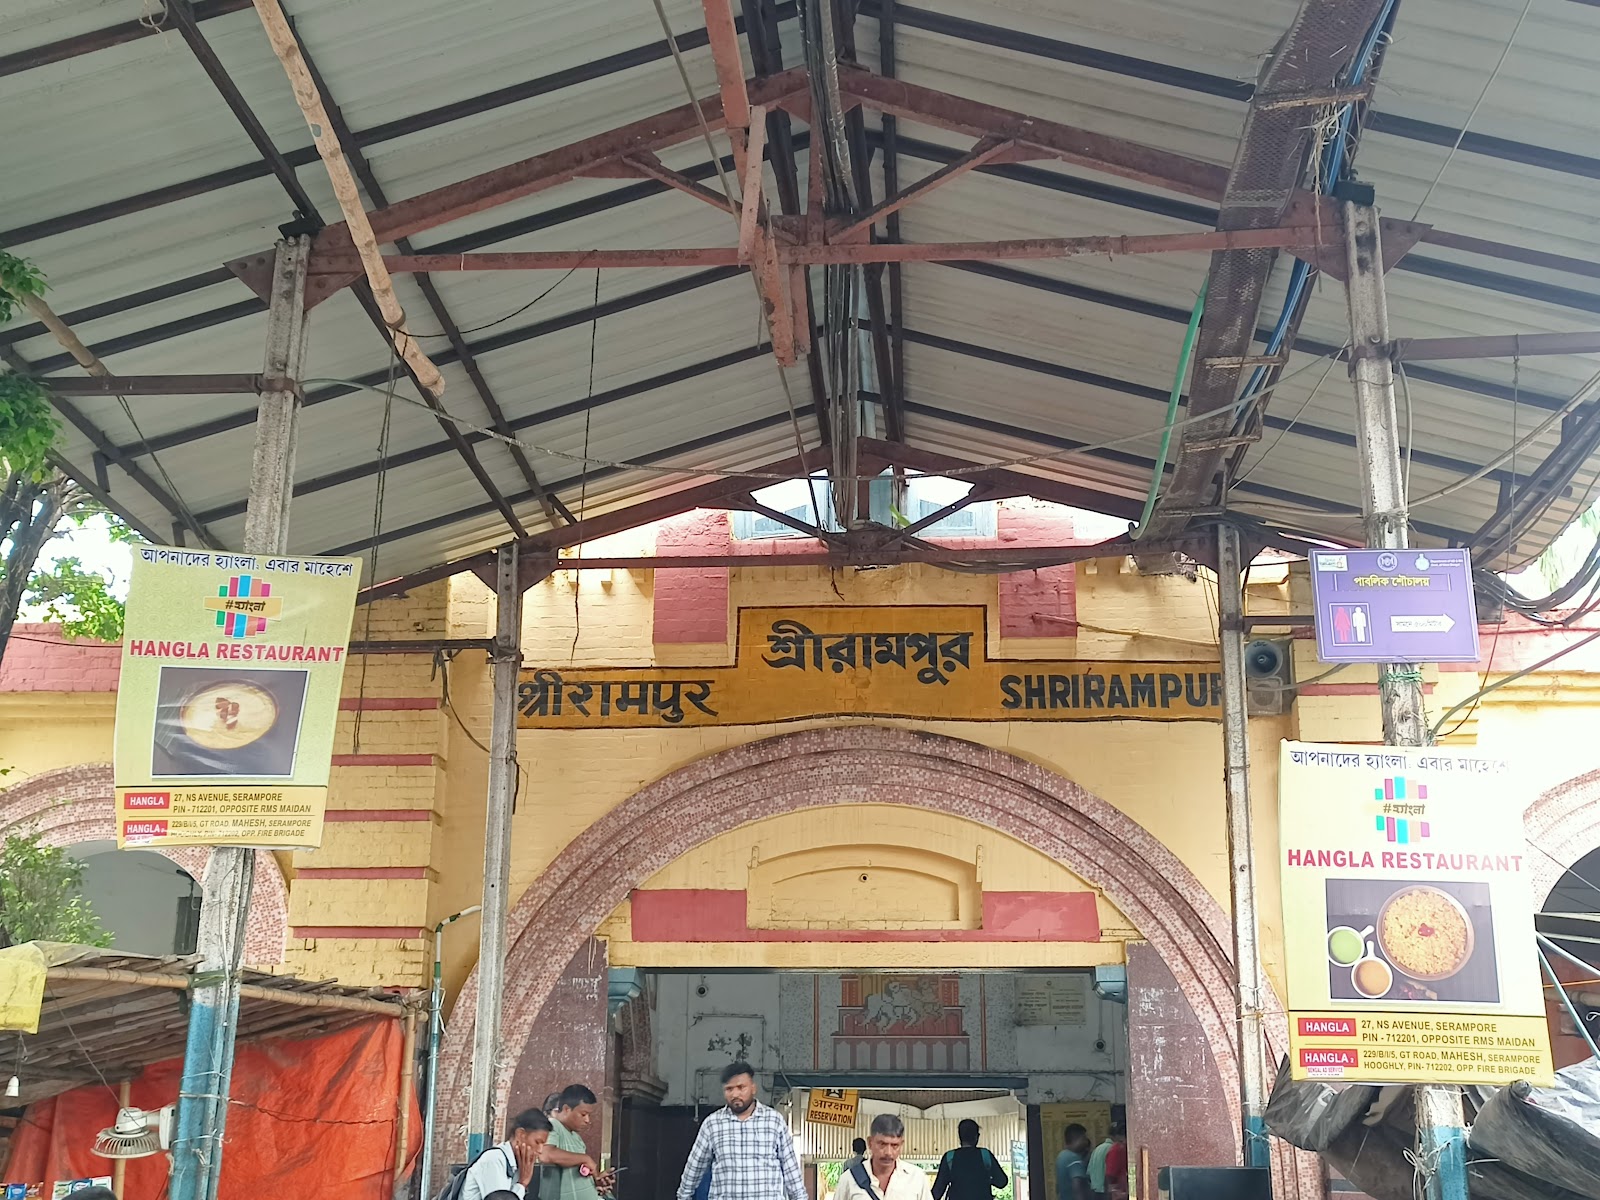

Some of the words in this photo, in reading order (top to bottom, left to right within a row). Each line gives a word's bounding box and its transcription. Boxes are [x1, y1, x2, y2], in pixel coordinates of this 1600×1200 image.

[140, 548, 210, 566] আপনাদের
[265, 560, 300, 572] এবার
[304, 562, 352, 576] মাহেশে
[1354, 574, 1390, 587] পাবলিক
[130, 640, 209, 658] HANGLA
[217, 643, 343, 662] RESTAURANT
[761, 619, 974, 686] শ্রীরামপুর
[518, 670, 718, 723] श्रीरामपुर
[1290, 751, 1360, 768] আপনাদের
[1417, 757, 1452, 771] এবার
[130, 794, 165, 805] HANGLA
[174, 794, 184, 802] 27,
[198, 793, 230, 802] AVENUE,
[232, 793, 282, 801] SERAMPORE
[173, 805, 186, 813] PIN
[192, 805, 218, 814] 712201,
[220, 805, 258, 813] OPPOSITE
[260, 804, 278, 812] RMS
[280, 804, 312, 812] MAIDAN
[127, 824, 160, 834] HANGLA
[232, 818, 266, 828] MAHESH,
[1288, 849, 1374, 868] HANGLA
[1382, 852, 1522, 872] RESTAURANT
[1305, 1022, 1350, 1032] HANGLA
[1362, 1020, 1374, 1030] 27,
[1376, 1020, 1390, 1029] NS
[1392, 1020, 1434, 1030] AVENUE,
[1436, 1022, 1496, 1032] SERAMPORE
[1362, 1033, 1378, 1042] PIN
[1386, 1034, 1420, 1044] 712201,
[1422, 1034, 1470, 1044] OPPOSITE
[1473, 1036, 1494, 1046] RMS
[1497, 1037, 1535, 1047] MAIDAN
[1305, 1053, 1348, 1062] HANGLA
[1441, 1052, 1486, 1062] MAHESH,
[1488, 1054, 1540, 1064] SERAMPORE
[1364, 1062, 1406, 1070] HOOGHLY,
[1408, 1062, 1424, 1070] PIN-
[1426, 1063, 1454, 1072] 712202,
[1478, 1065, 1496, 1073] FIRE
[1498, 1066, 1536, 1074] BRIGADE
[812, 1099, 854, 1112] आरक्षण
[810, 1110, 852, 1124] RESERVATION
